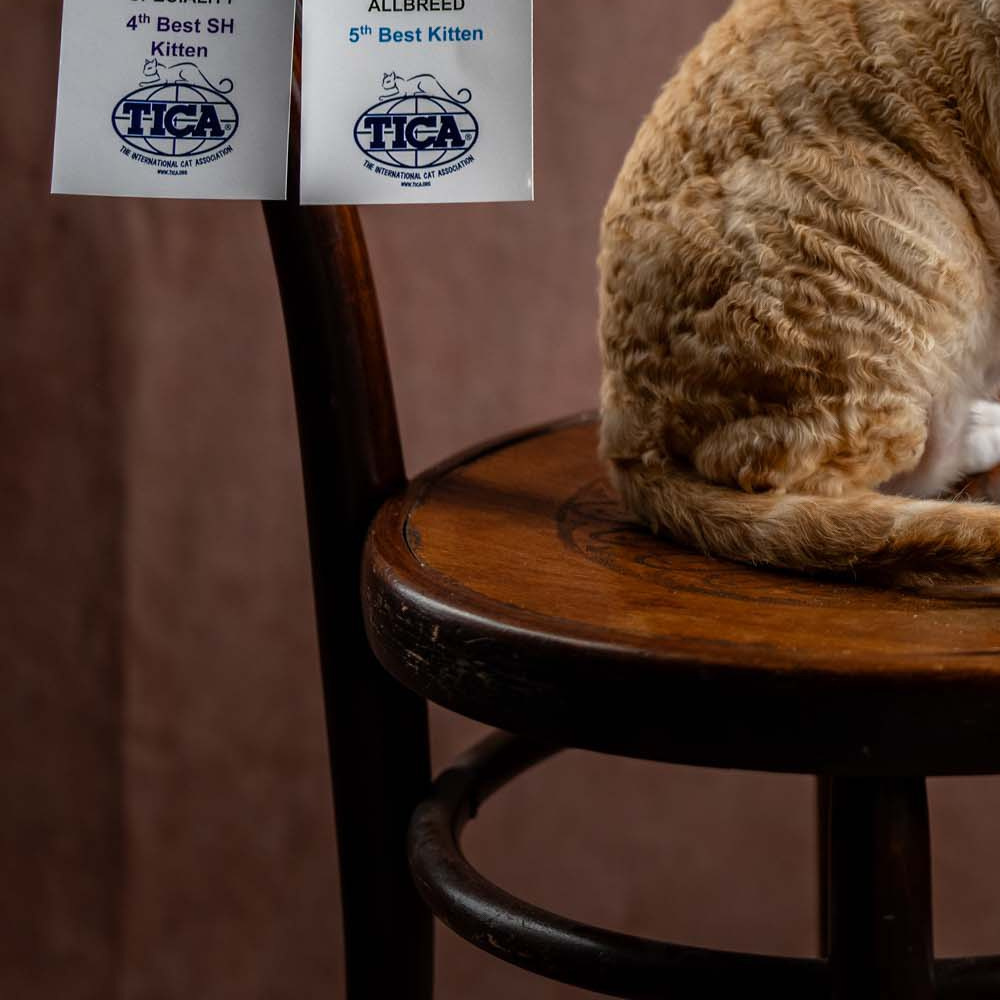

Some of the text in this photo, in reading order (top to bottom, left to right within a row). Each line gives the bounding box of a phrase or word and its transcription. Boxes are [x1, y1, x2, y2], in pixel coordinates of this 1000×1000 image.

[126, 13, 234, 34] 4th Best SH
[349, 25, 483, 43] 5th Best Kitten
[151, 41, 208, 58] Kitten
[123, 102, 225, 137] TICA
[364, 116, 466, 149] TICA
[120, 145, 233, 168] THE INTERNATIONAL CAT ASSOCIATION
[363, 154, 475, 180] THE INTERNATIONAL CAT ASSOCIATION
